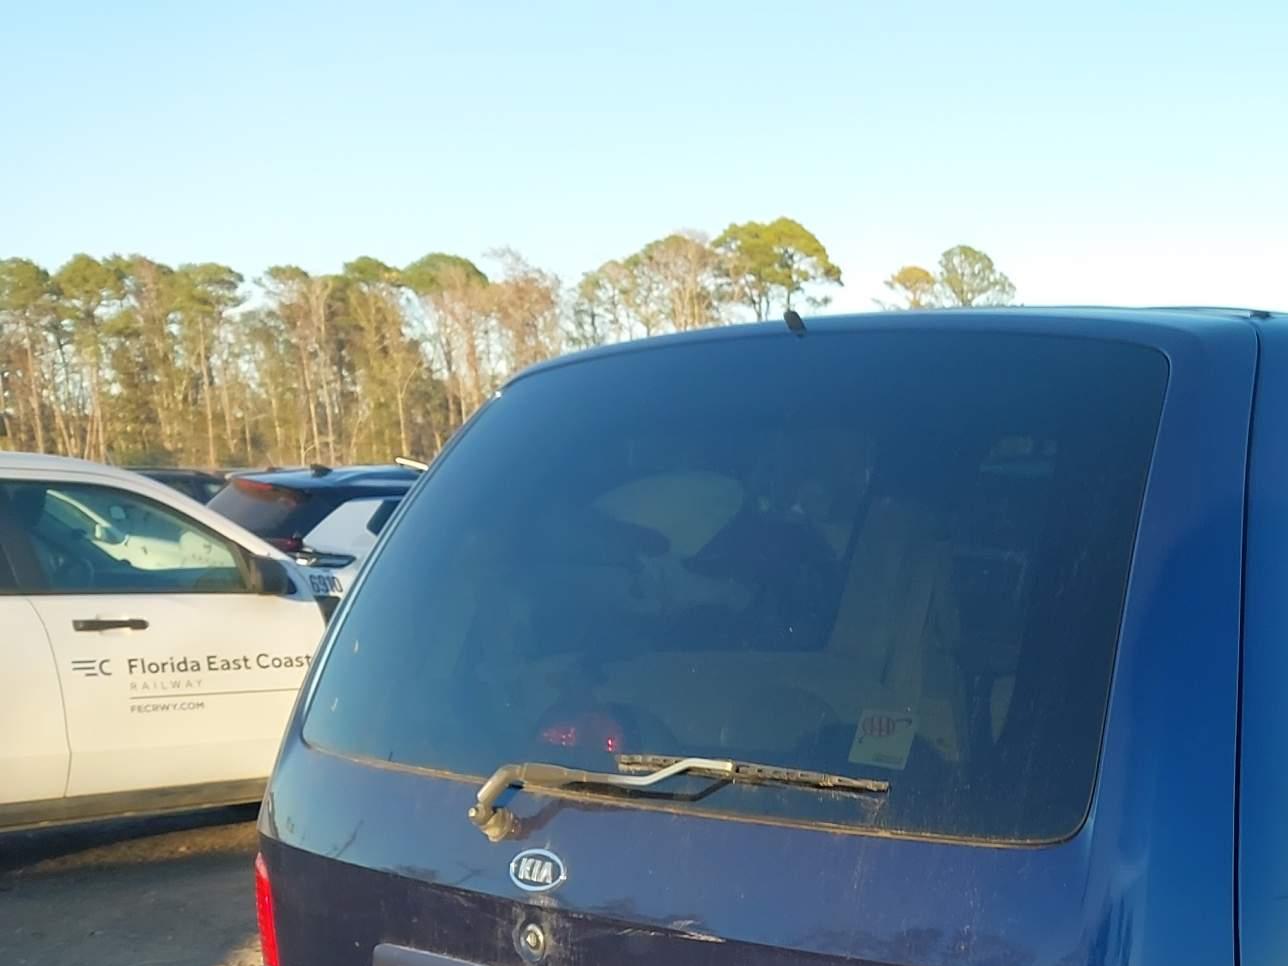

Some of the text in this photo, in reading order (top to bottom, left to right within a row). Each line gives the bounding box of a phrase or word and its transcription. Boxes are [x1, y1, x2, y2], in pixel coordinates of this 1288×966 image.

[127, 653, 311, 675] Florida East Coast
[129, 679, 204, 691] RAILWAY
[129, 702, 206, 714] FECRWY.COM
[518, 857, 553, 884] KIA
